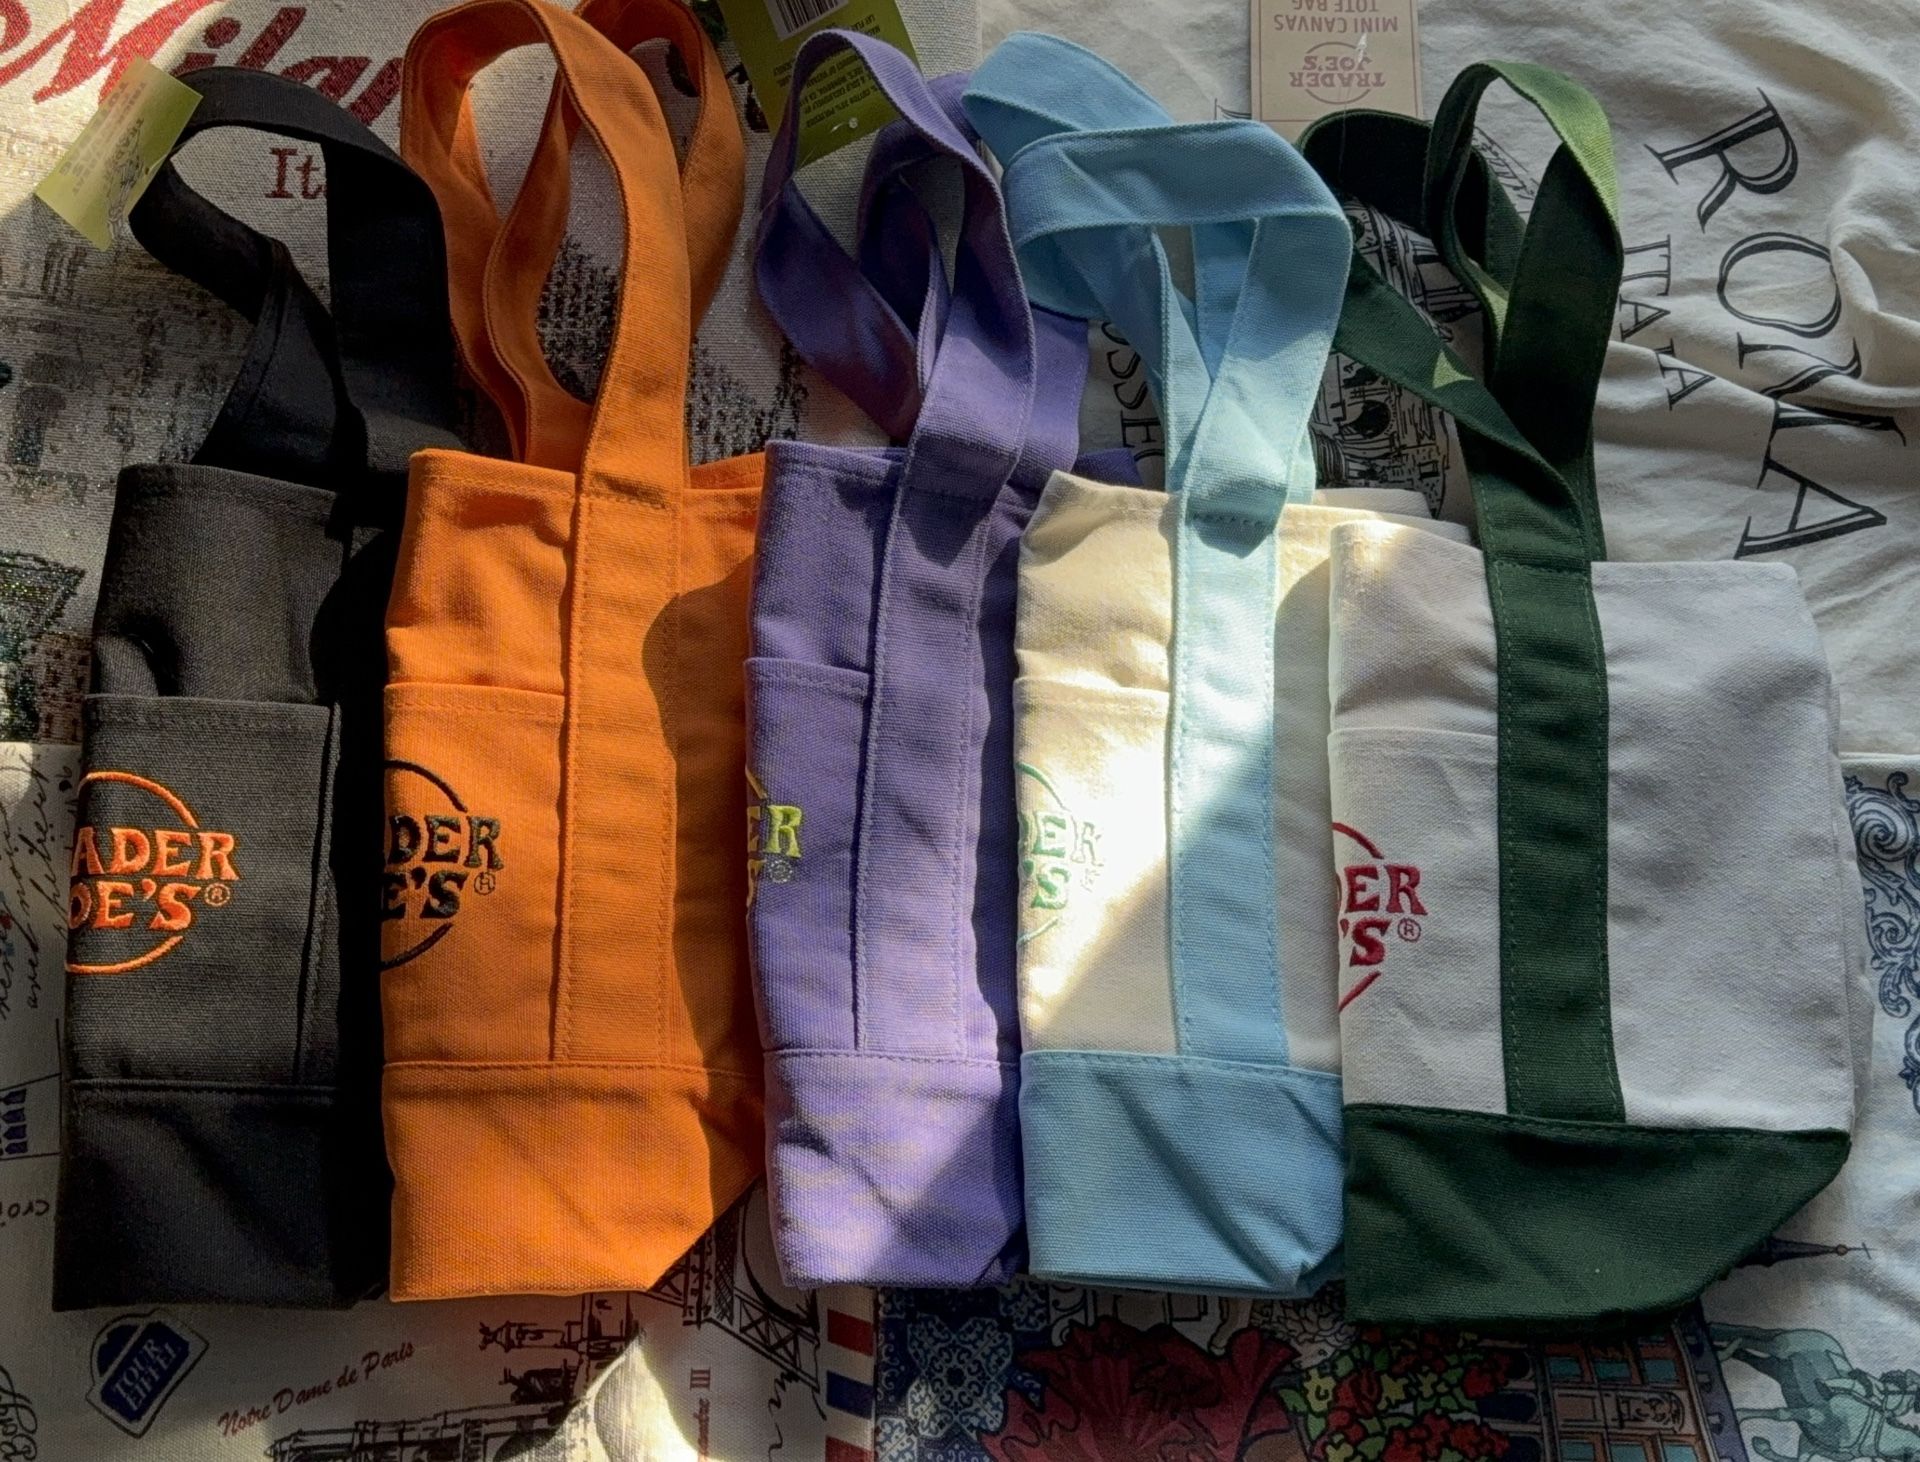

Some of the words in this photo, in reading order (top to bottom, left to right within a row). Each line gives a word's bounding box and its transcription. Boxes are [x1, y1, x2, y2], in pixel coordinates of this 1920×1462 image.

[1274, 14, 1347, 34] CANVAS
[1354, 15, 1398, 33] MINI
[0, 0, 402, 127] Mila
[1289, 72, 1386, 88] TRADER
[1302, 55, 1373, 72] JOE'S
[264, 147, 326, 200] It
[71, 826, 240, 881] ADER
[386, 813, 504, 870] DER
[68, 879, 202, 931] OE'S
[110, 1336, 160, 1398] TOUR
[215, 1401, 272, 1437] Notre
[270, 1378, 333, 1414] Dame
[331, 1365, 359, 1389] de
[358, 1340, 415, 1379] Paris
